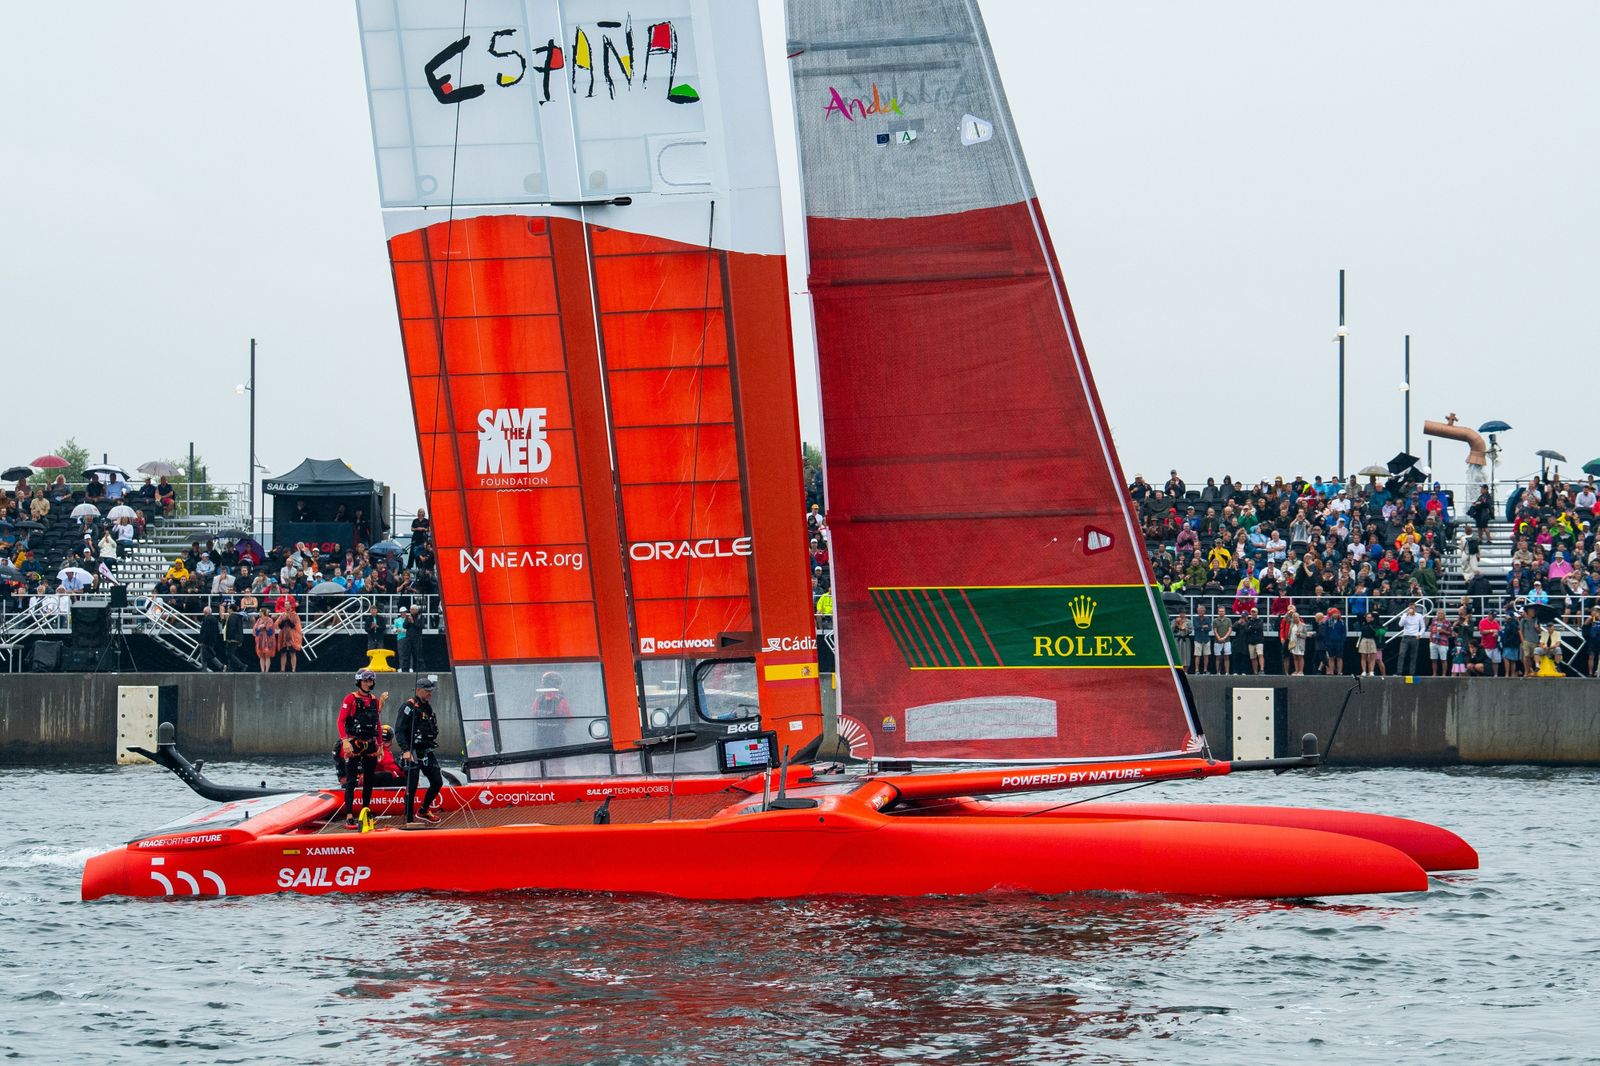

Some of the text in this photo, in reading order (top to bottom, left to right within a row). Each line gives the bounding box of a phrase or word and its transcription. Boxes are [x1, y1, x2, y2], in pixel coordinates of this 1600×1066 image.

[424, 12, 700, 105] ESPAÑA
[477, 408, 547, 440] SAVE
[501, 428, 525, 440] THE
[477, 439, 552, 475] MED
[481, 477, 548, 486] FOUNDATION
[629, 536, 752, 561] ORACLE
[491, 551, 583, 570] NEAR.org
[657, 639, 714, 649] ROCKWOOL
[782, 636, 817, 650] Cádiz
[1033, 635, 1136, 657] ROLEX
[727, 721, 760, 734] B&G
[1001, 775, 1067, 787] POWERED
[1069, 772, 1088, 783] BY
[613, 785, 670, 795] TECHNOLOGIES
[496, 791, 555, 804] cognizant
[138, 834, 222, 848] #RACEFORTHEFUTURE
[306, 846, 355, 856] XAMMAR
